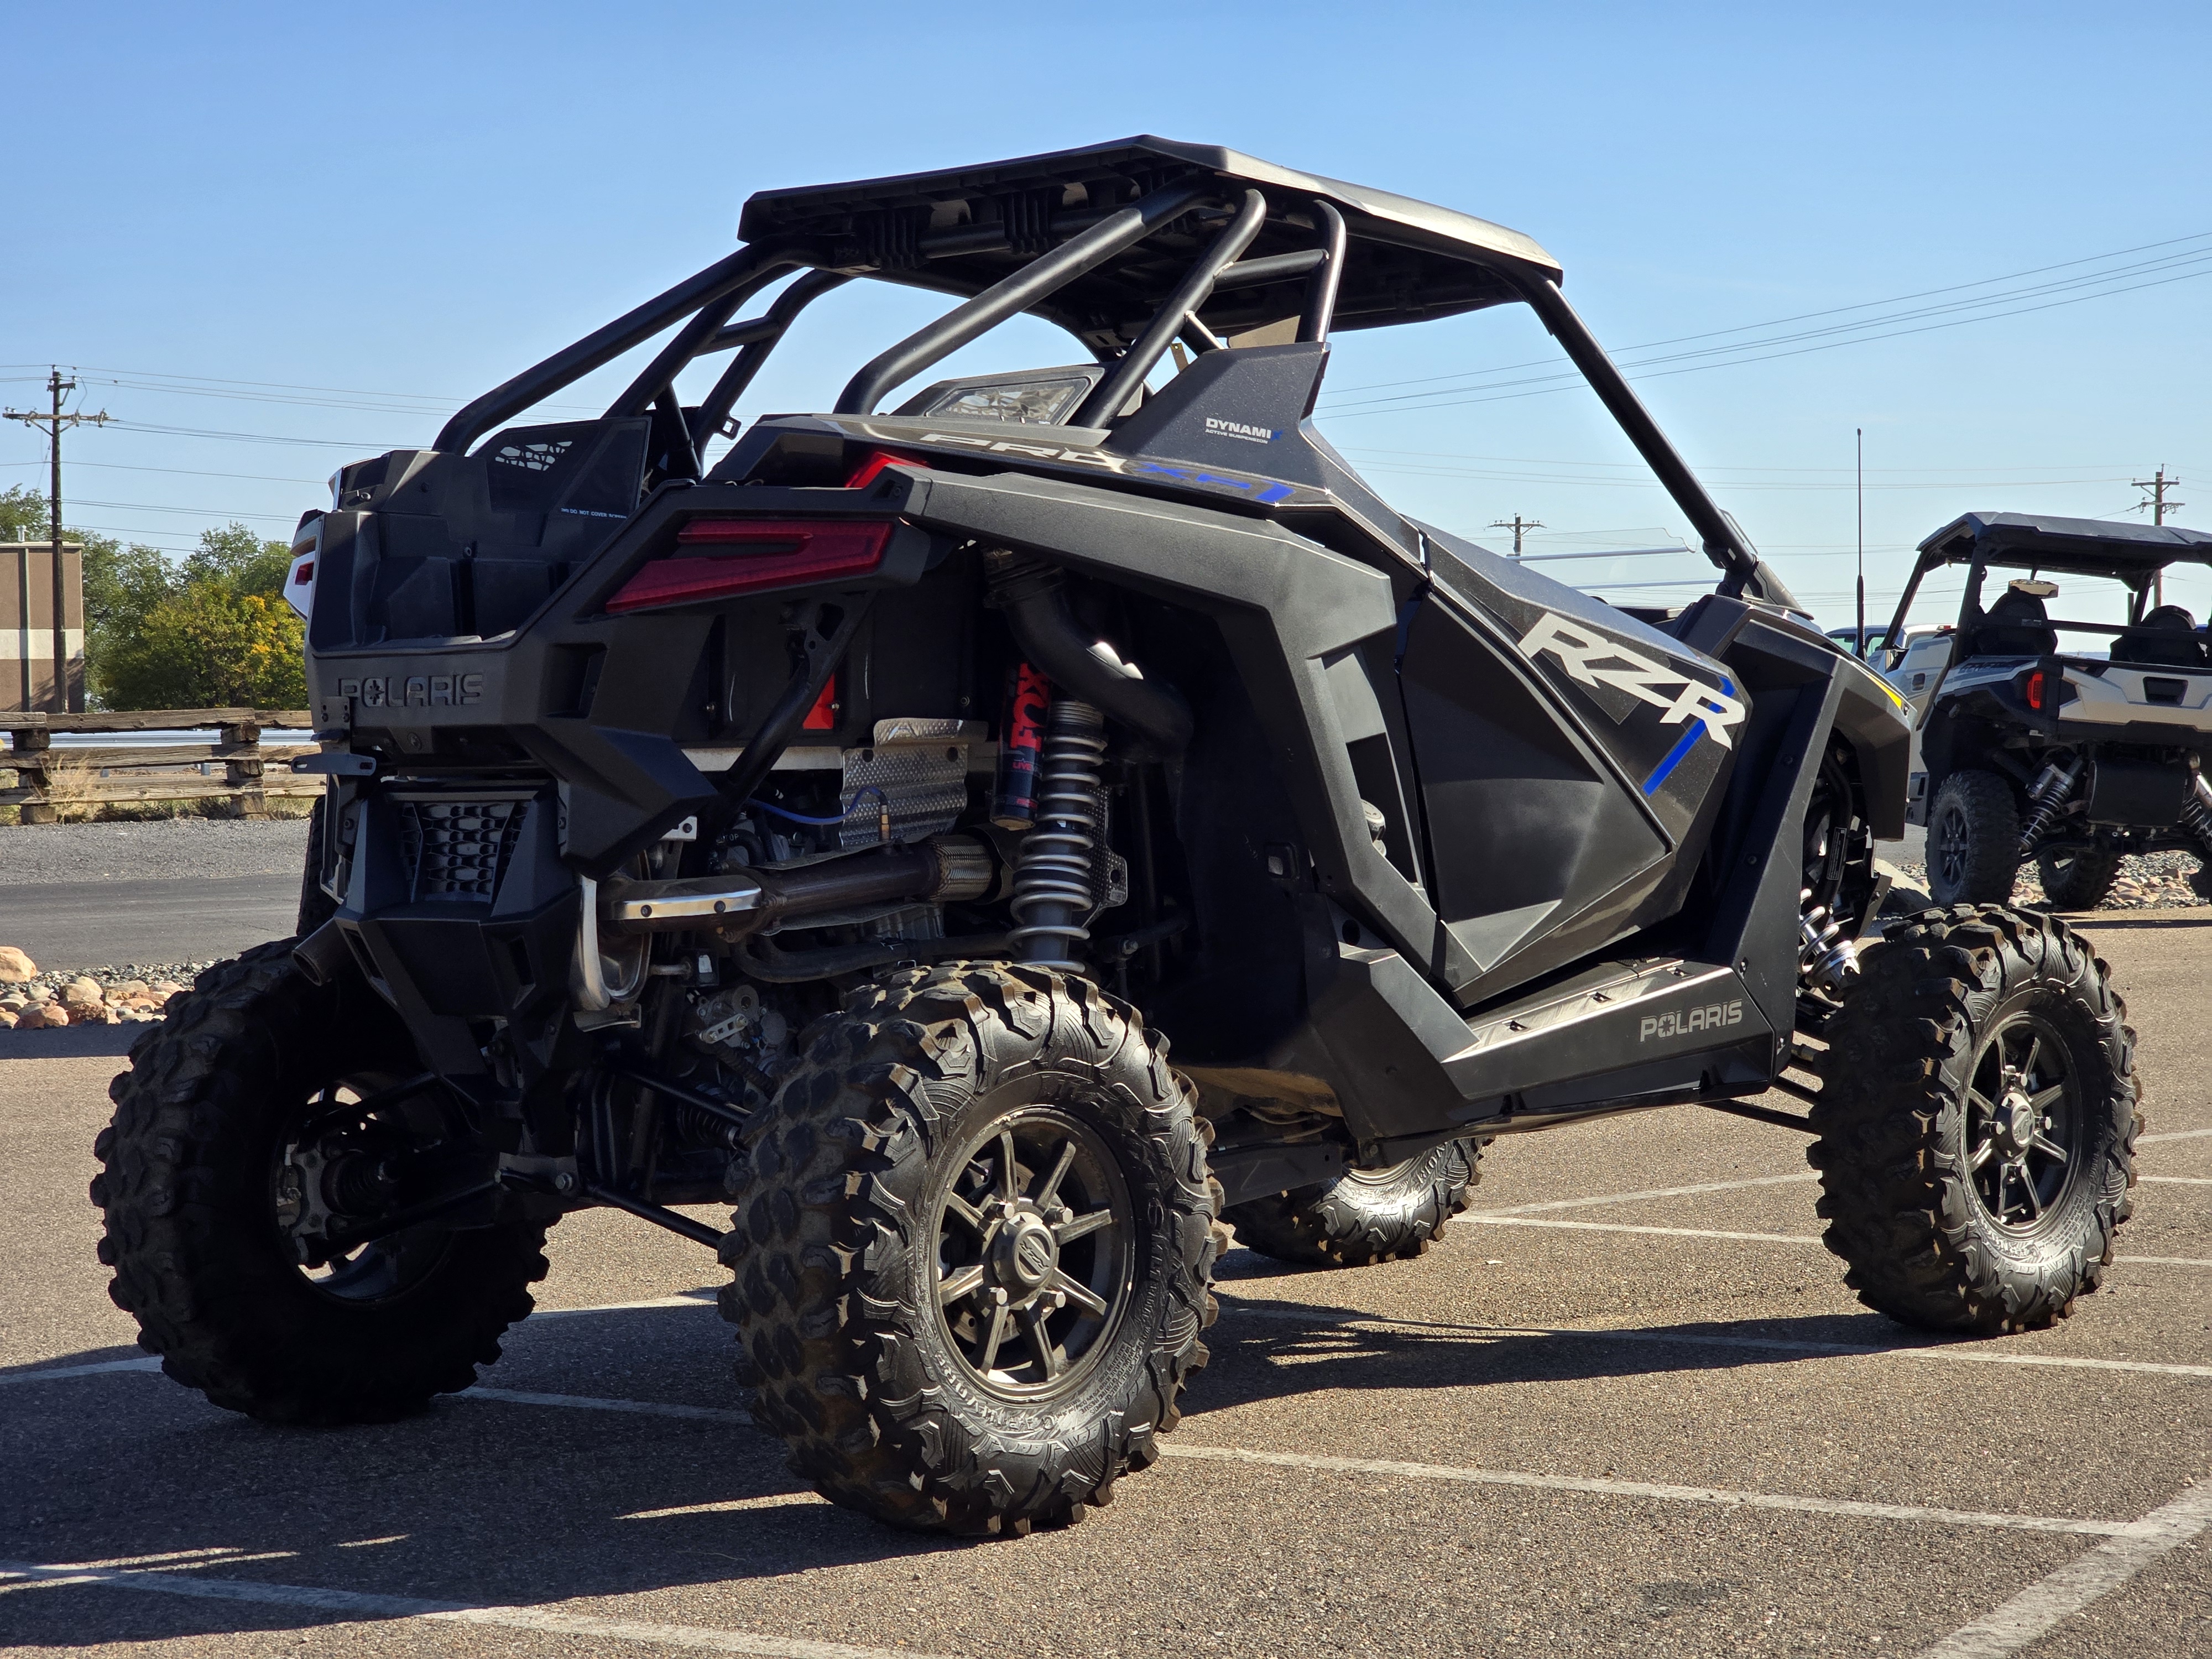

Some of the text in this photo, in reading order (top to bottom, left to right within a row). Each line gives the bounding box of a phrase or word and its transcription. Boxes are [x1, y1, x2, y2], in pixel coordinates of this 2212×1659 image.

[919, 433, 1126, 473] PRO
[1205, 429, 1268, 444] ACTIVE SUSPENSION
[338, 673, 484, 708] POLARIS
[1518, 612, 1746, 751] RZR
[1640, 999, 1743, 1042] POLARIS
